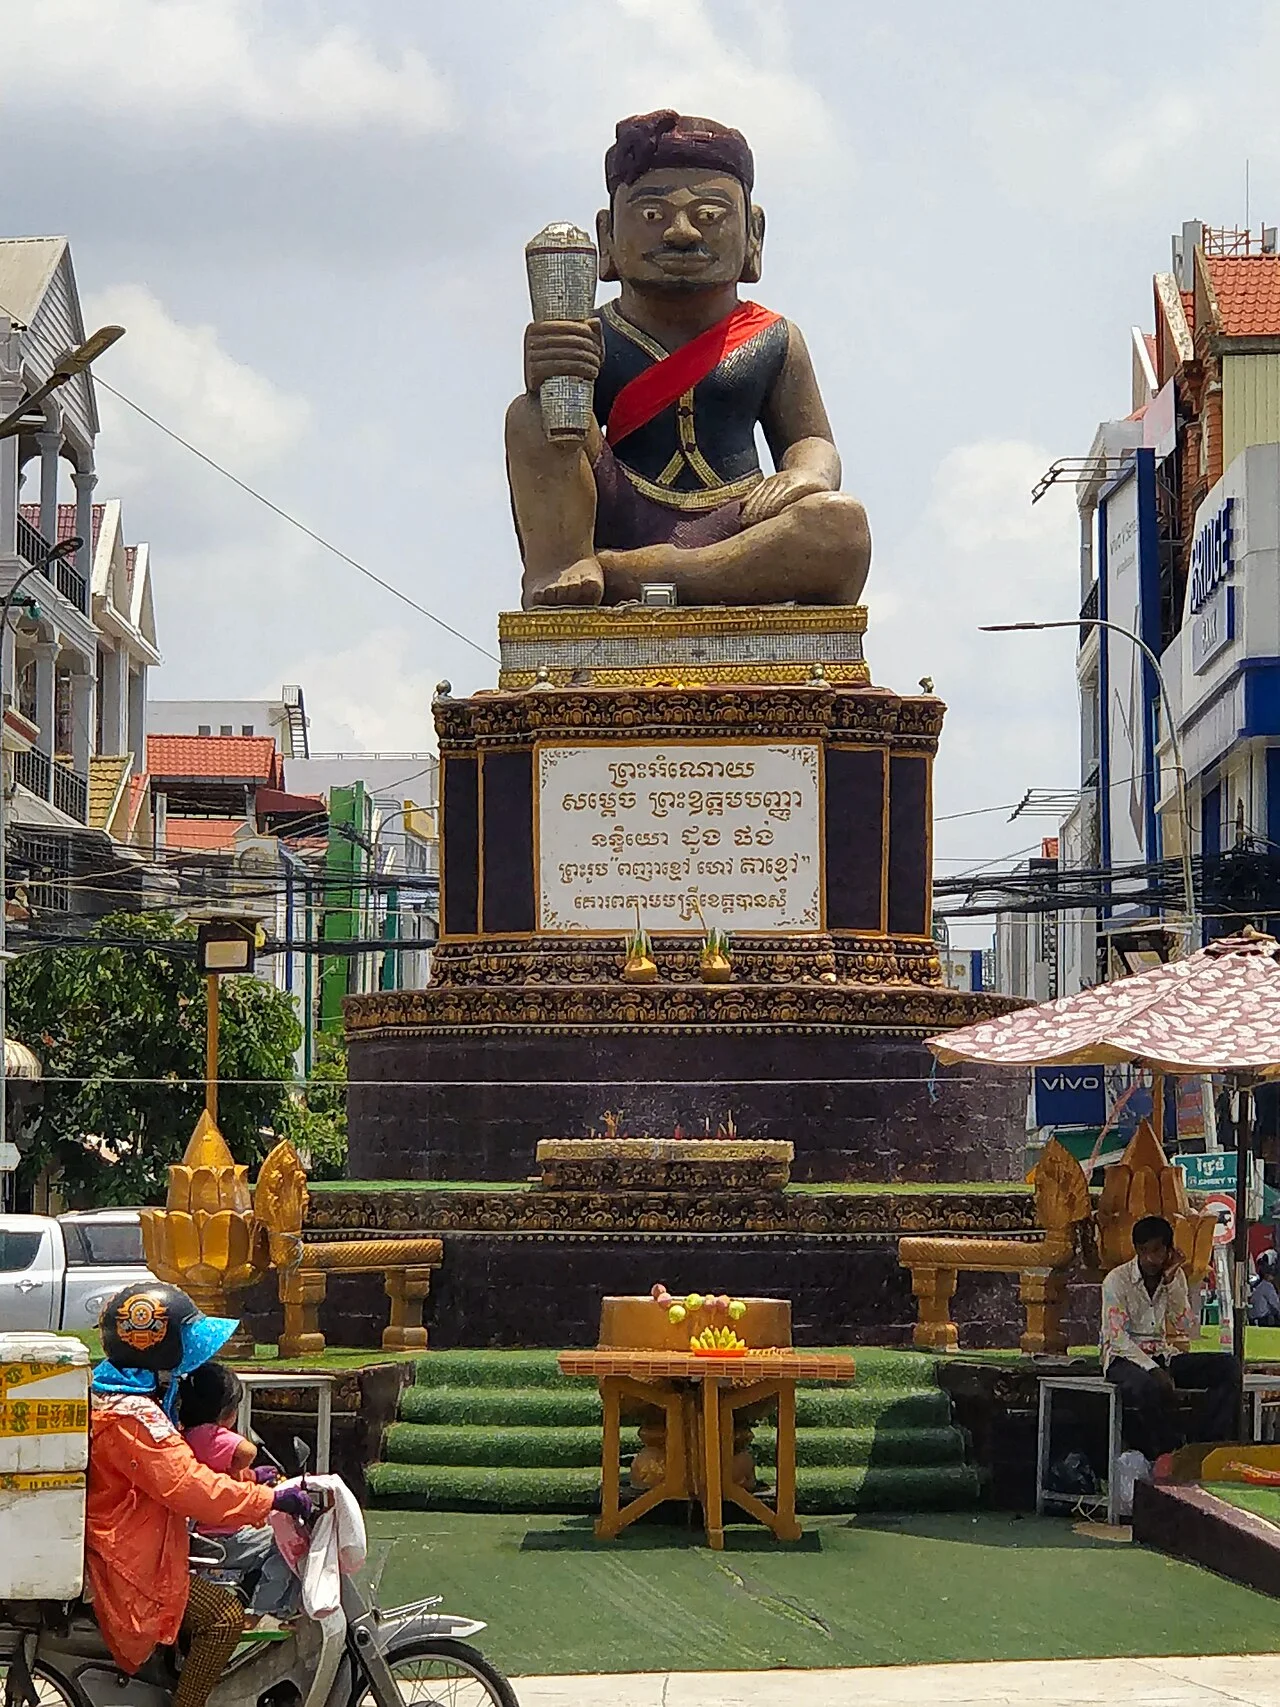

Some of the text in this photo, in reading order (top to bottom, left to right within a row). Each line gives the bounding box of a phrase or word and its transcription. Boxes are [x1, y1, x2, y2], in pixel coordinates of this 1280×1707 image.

[1191, 498, 1232, 613] BRIDGE
[607, 754, 756, 788] ព្រះអំណោយ
[1041, 1073, 1099, 1090] vivo
